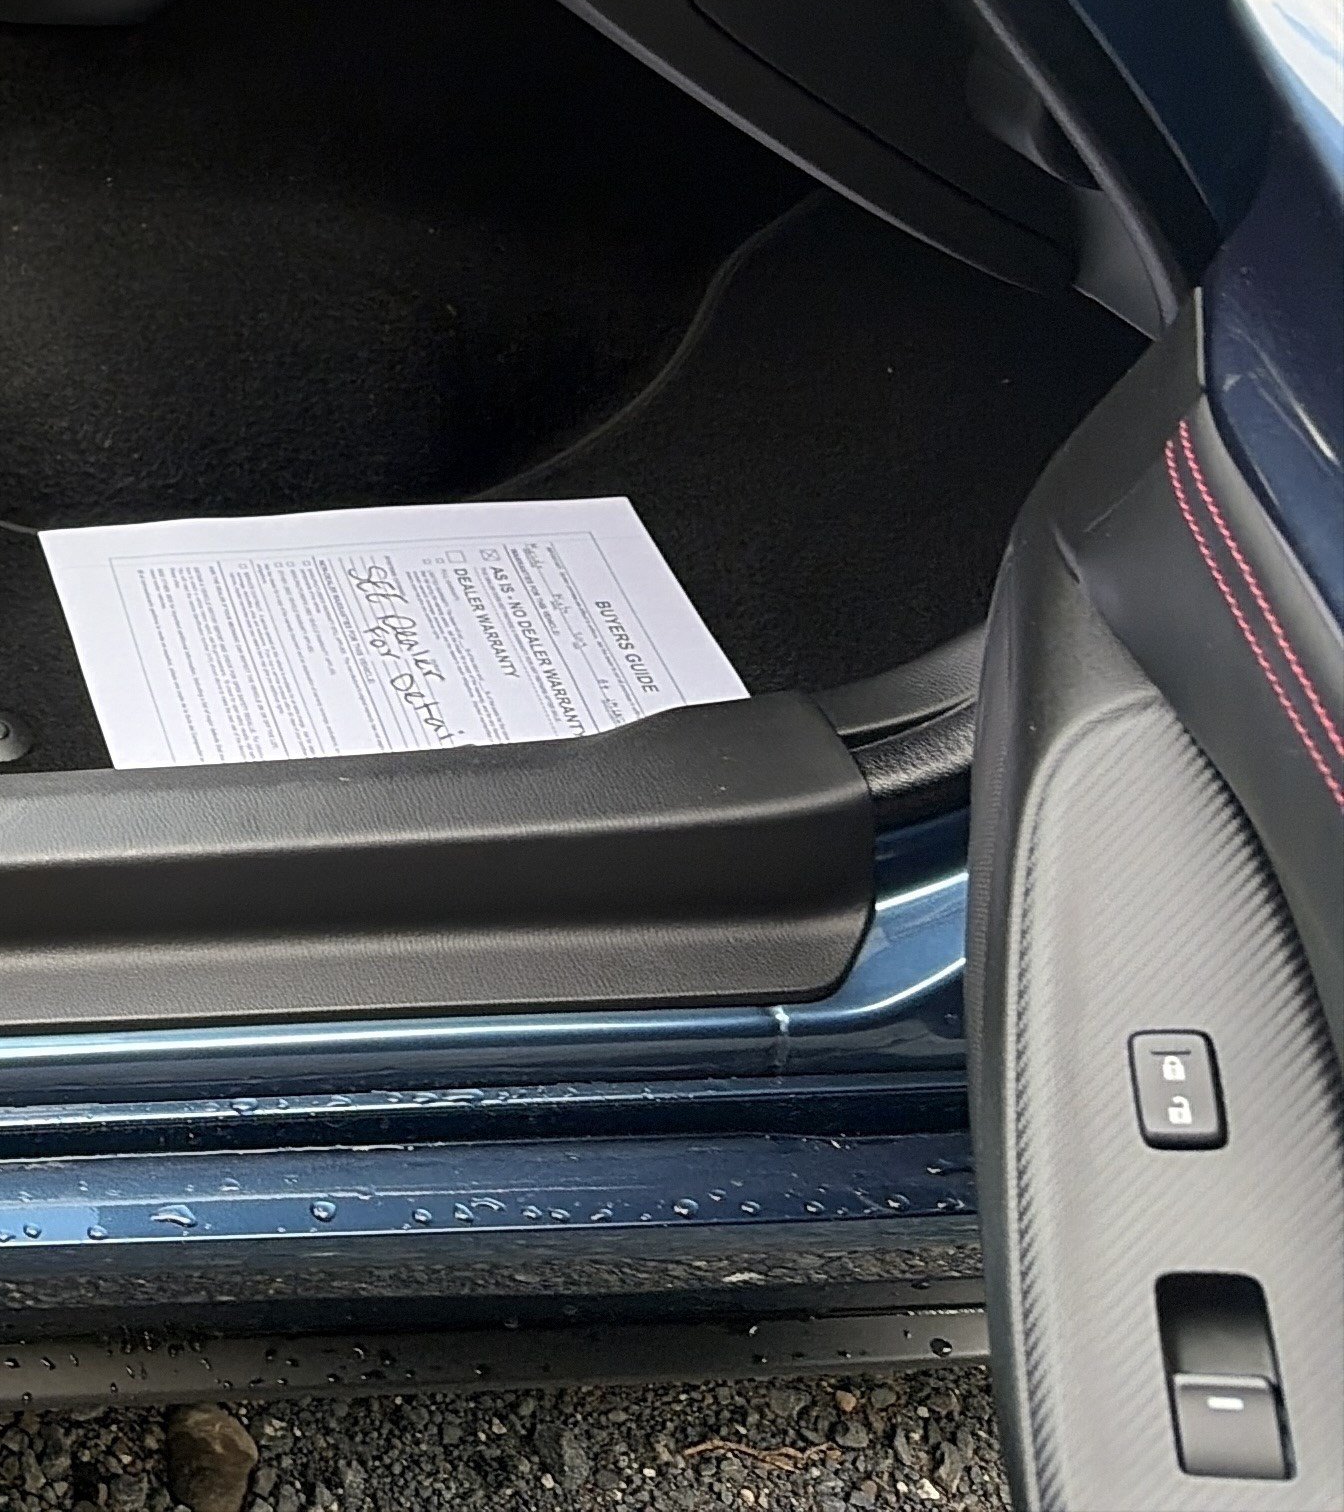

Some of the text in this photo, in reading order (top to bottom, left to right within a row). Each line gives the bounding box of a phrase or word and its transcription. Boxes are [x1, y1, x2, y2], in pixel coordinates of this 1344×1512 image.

[490, 566, 508, 581] AS
[500, 583, 515, 594] IS
[454, 568, 520, 679] DEALER WARRANTY
[508, 601, 527, 618] NO
[517, 620, 553, 666] DEALER
[595, 601, 635, 651] BUYERS
[625, 653, 660, 694] GUIDE
